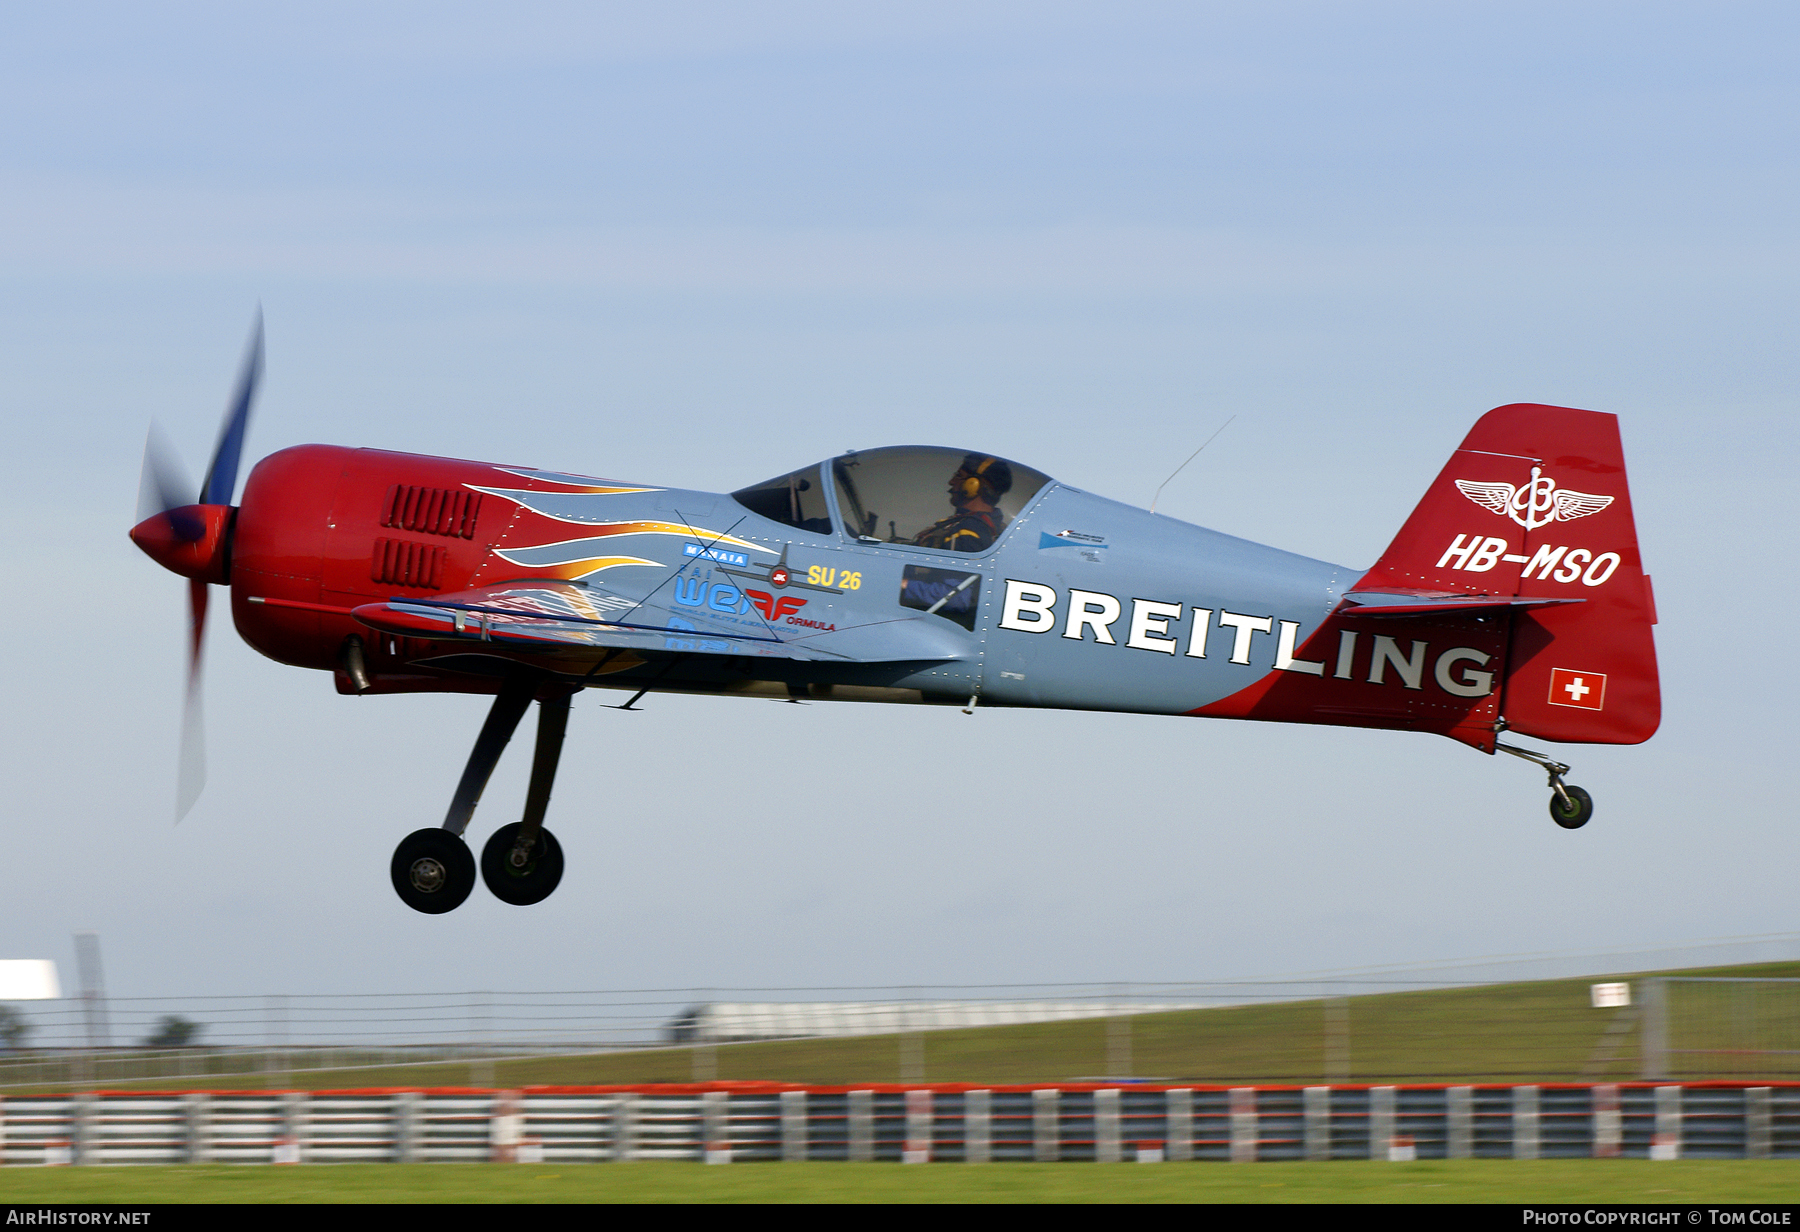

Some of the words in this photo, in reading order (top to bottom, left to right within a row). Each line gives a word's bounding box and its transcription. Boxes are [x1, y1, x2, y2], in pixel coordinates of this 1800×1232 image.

[807, 564, 836, 587] SU
[838, 570, 862, 590] 26
[1435, 533, 1621, 587] HB-MSO
[998, 578, 1495, 699] BREITLING
